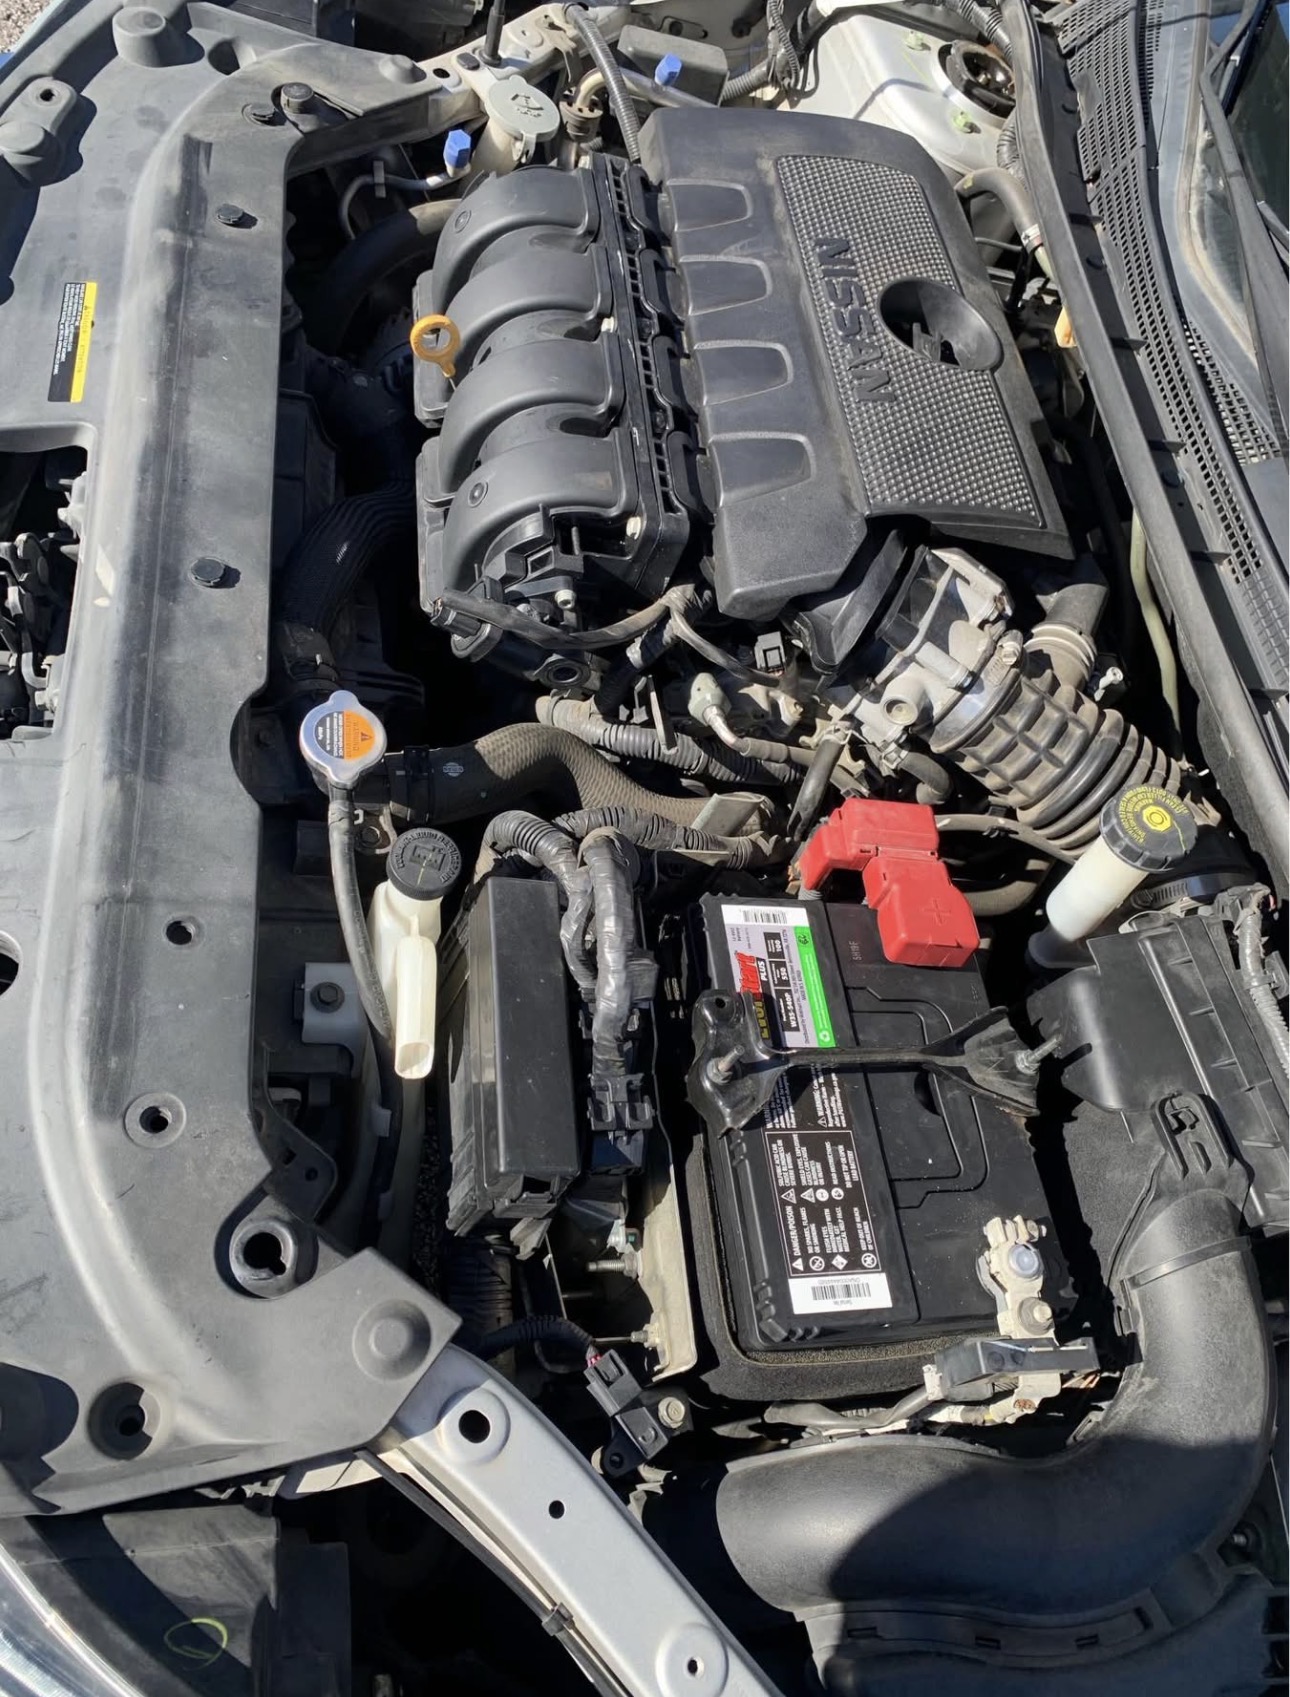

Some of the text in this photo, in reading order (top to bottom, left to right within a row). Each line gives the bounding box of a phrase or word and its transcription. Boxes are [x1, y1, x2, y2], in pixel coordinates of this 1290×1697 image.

[815, 237, 896, 402] NISSAN
[774, 940, 783, 952] 100
[757, 960, 768, 981] PLUS
[779, 967, 788, 980] 550
[847, 1150, 856, 1169] BATTERY
[799, 1207, 809, 1226] FLAMES
[785, 1206, 801, 1256] DANGER/POISON
